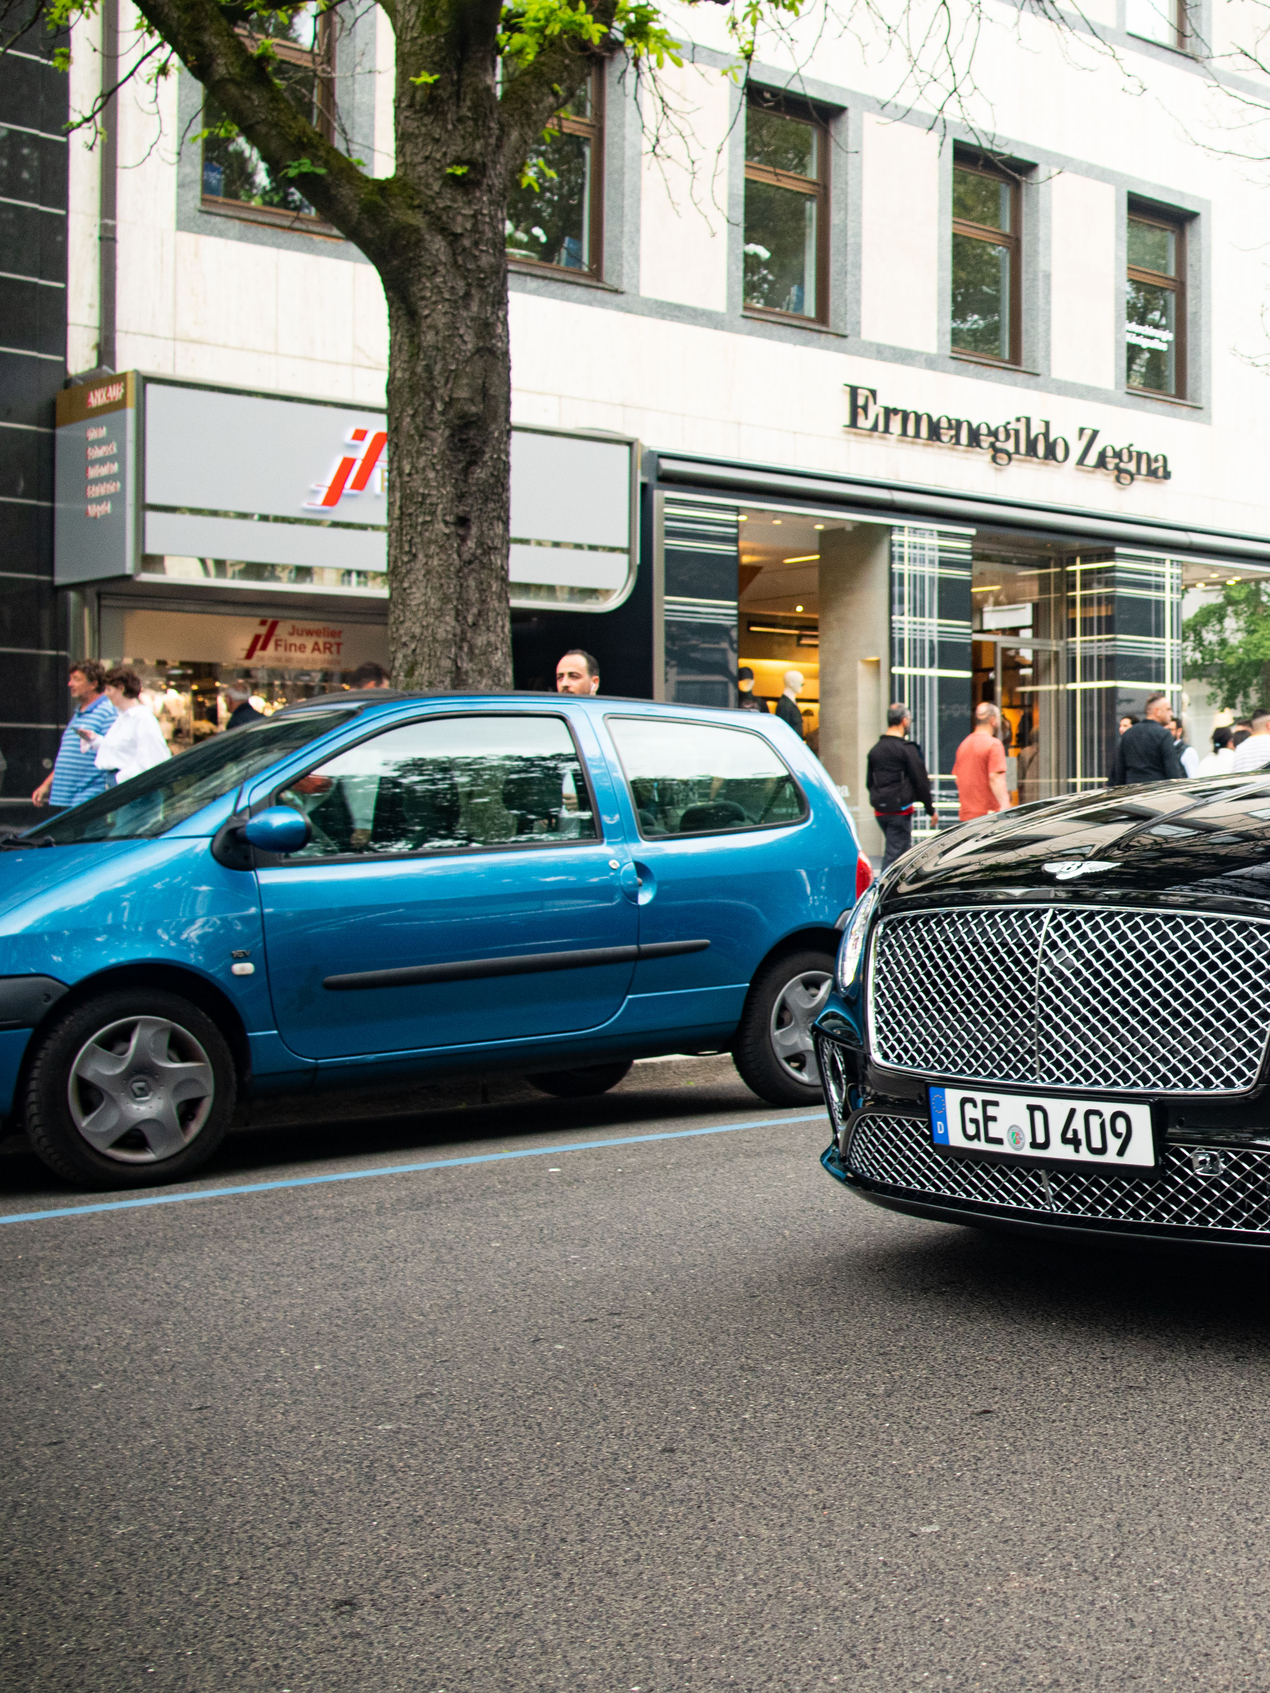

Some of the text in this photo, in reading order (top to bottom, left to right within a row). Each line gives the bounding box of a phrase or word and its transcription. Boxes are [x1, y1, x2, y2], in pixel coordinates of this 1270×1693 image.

[843, 383, 1171, 485] Ermenegildo Zegna
[288, 625, 343, 638] Juwelier
[274, 639, 343, 655] Fine ART
[937, 1121, 945, 1134] D
[960, 1097, 1133, 1157] GE D 409
